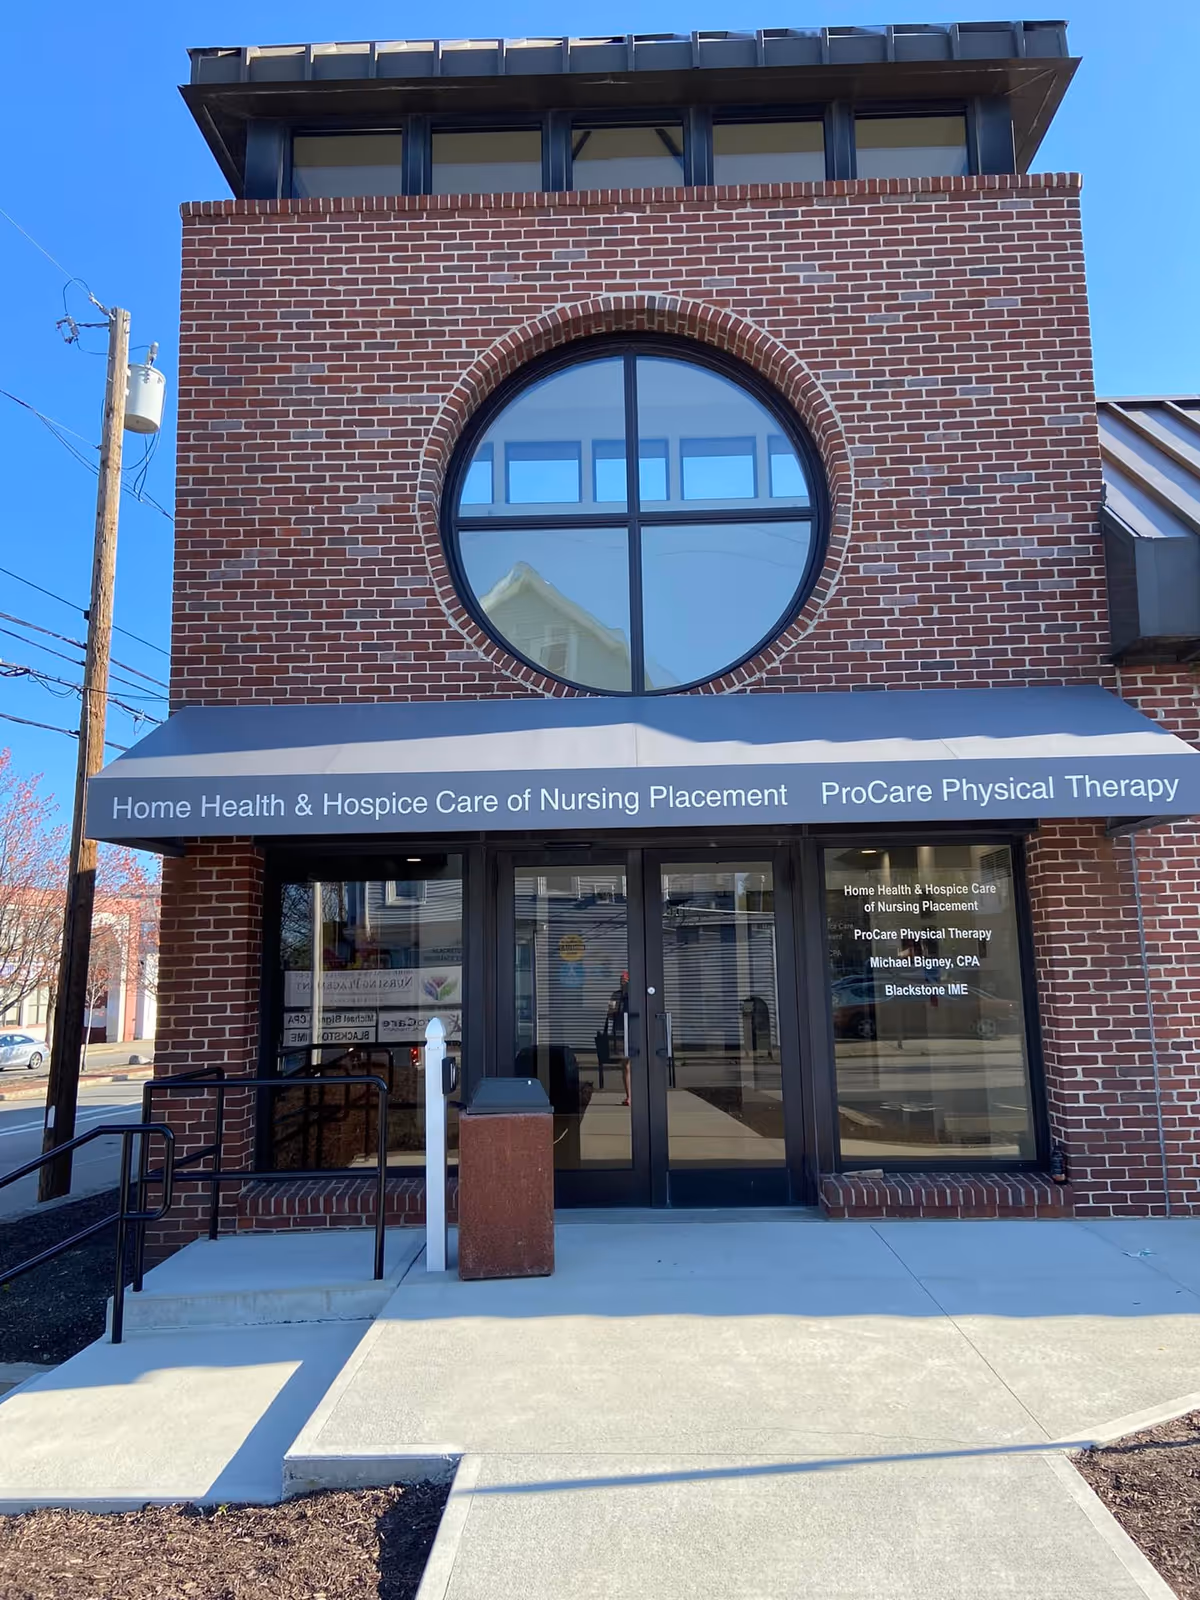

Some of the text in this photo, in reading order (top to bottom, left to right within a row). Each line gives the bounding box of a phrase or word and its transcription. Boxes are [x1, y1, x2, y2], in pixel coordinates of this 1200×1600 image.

[822, 775, 1179, 806] ProCare Physical Therapy
[113, 785, 788, 820] Home Health & Hospice Care of Nursing Placement
[844, 883, 996, 896] Home Health & Hospice Care
[864, 901, 978, 914] of Nursing Placement
[854, 929, 897, 940] ProCare
[900, 928, 945, 941] Physical
[948, 928, 991, 941] Therapy
[870, 956, 980, 969] Michael Bigney, CPA
[885, 984, 968, 995] Blackstone IME
